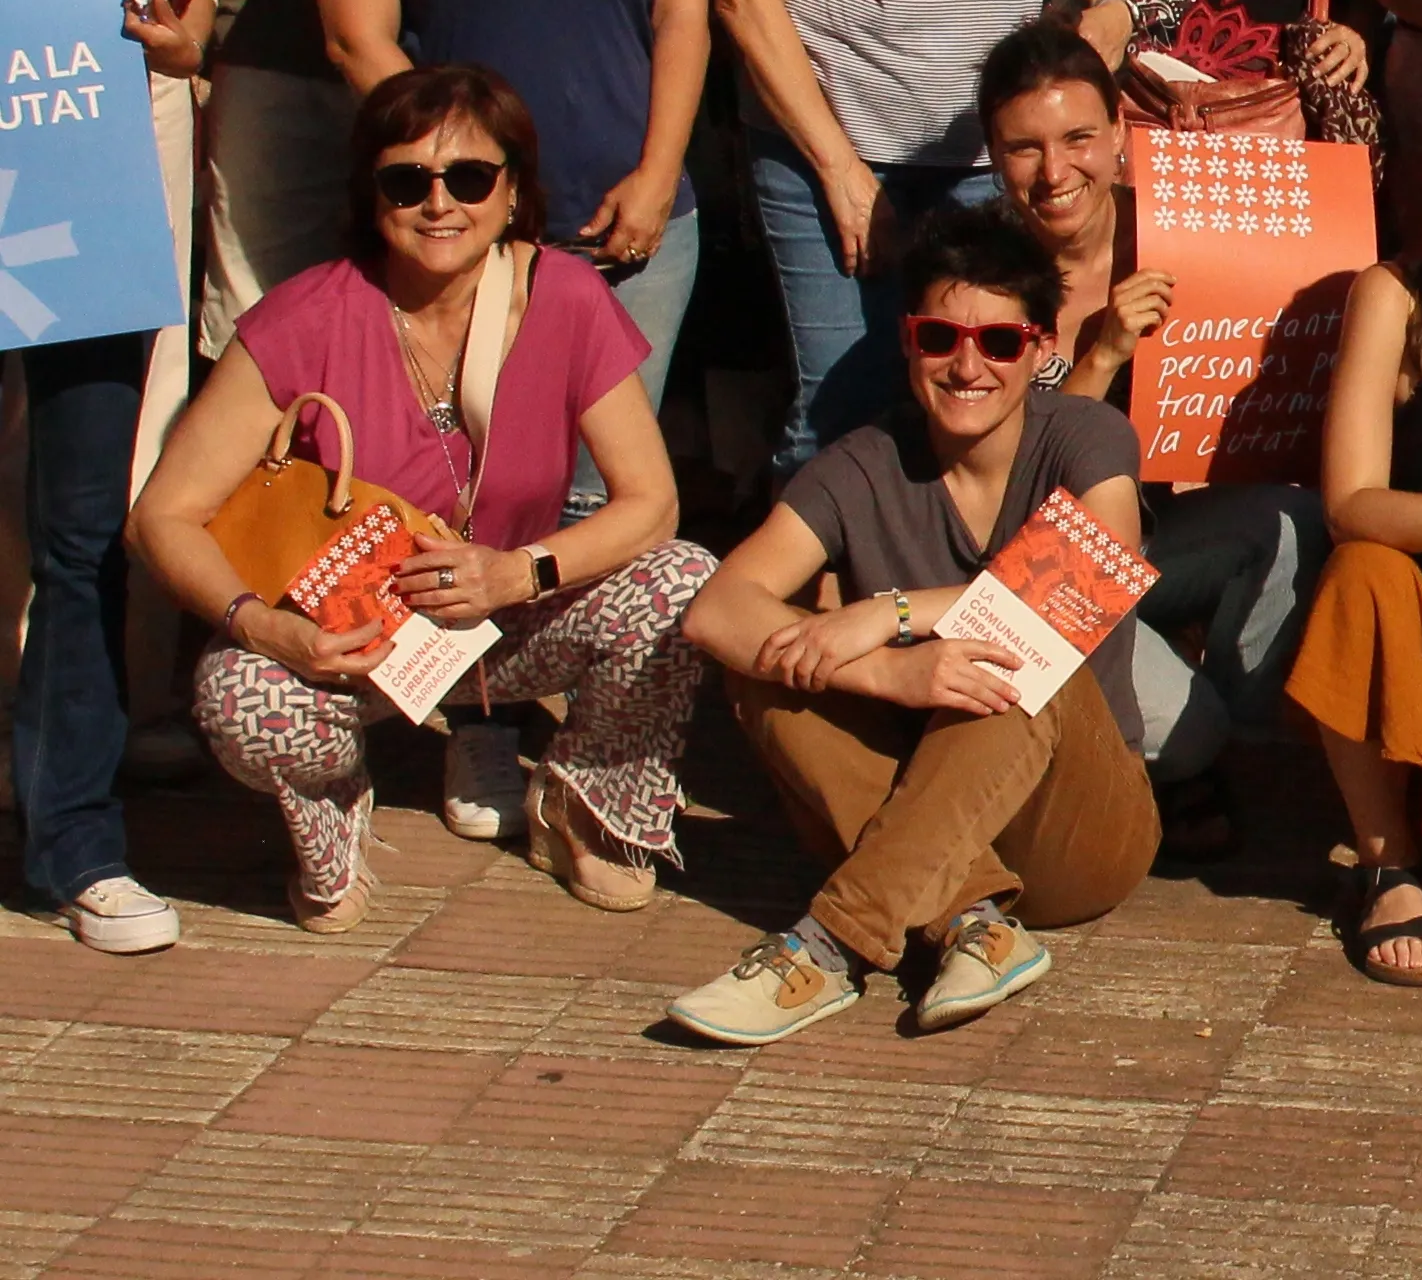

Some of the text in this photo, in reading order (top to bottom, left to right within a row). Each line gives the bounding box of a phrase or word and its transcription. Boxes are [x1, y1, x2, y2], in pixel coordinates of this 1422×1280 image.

[7, 41, 103, 84] A LA
[0, 84, 106, 130] UTAT
[1158, 352, 1288, 388] persones
[1147, 424, 1181, 460] la
[978, 587, 996, 605] LA
[959, 609, 1010, 652] URBAN
[969, 600, 1052, 672] COMUNALITAT
[380, 663, 397, 679] LA
[401, 637, 457, 699] URBANA DE
[411, 649, 467, 709] TARRAGONA
